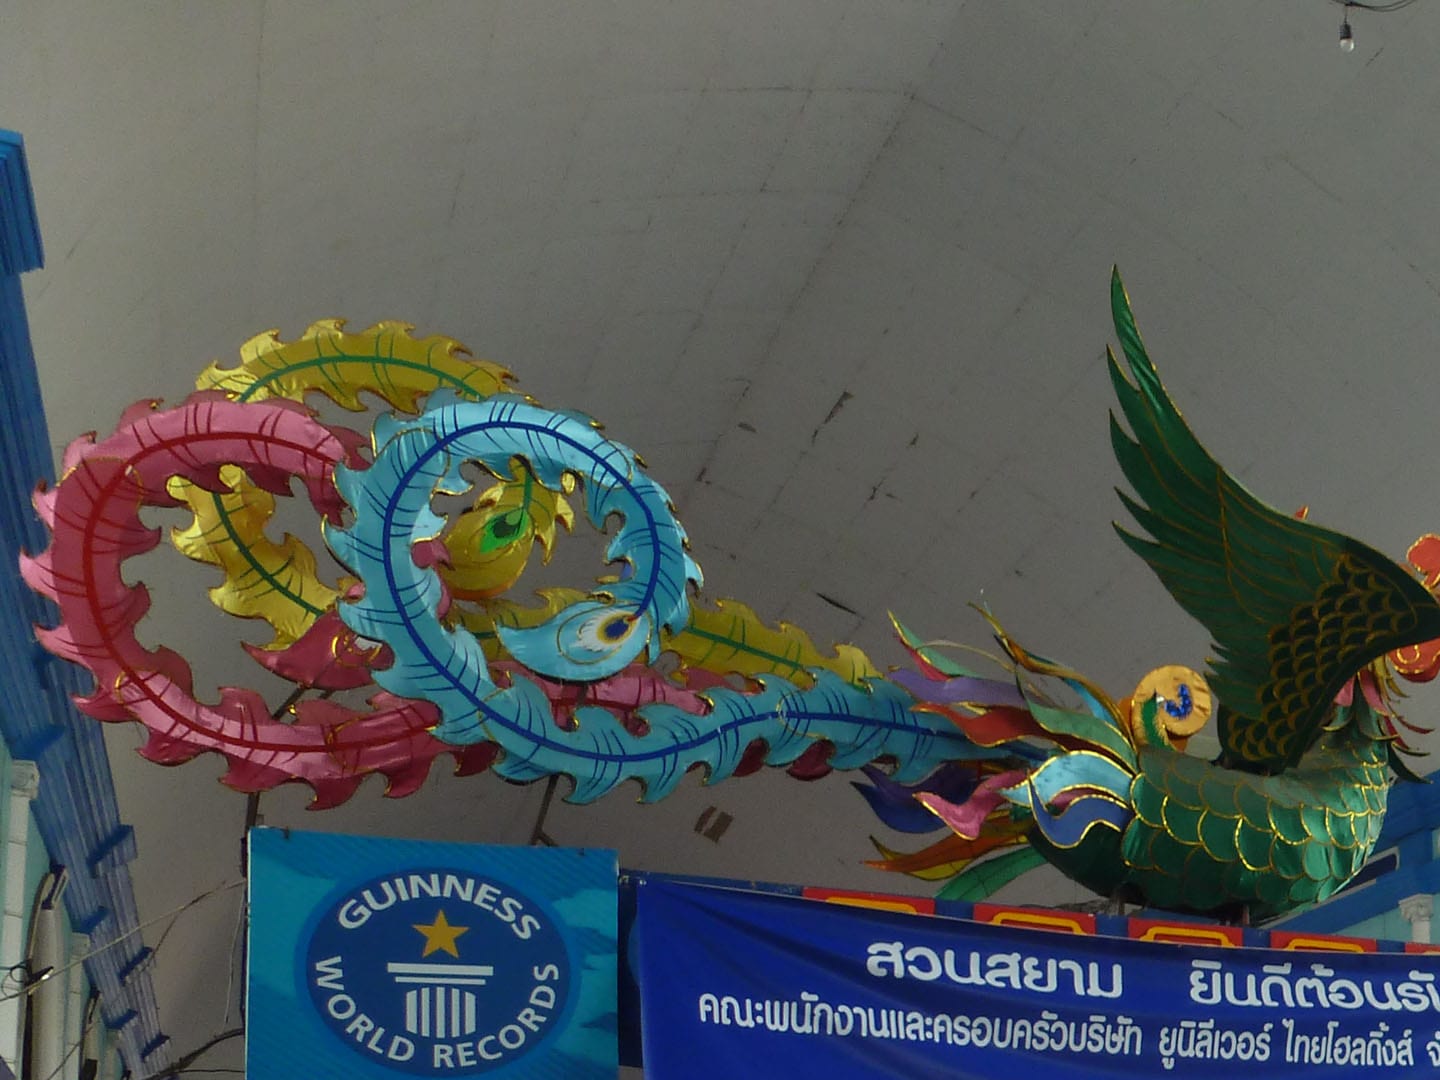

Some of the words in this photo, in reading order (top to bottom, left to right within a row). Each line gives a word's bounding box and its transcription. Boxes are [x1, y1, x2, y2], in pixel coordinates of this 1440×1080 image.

[337, 873, 541, 940] GUINNESS
[866, 941, 1123, 999] สวนสยาม
[314, 955, 415, 1063] WORLD
[433, 963, 560, 1069] RECORDS
[699, 991, 1143, 1057] คณะพนักงานและครอบครัวบริษัท
[1159, 1020, 1273, 1069] ยูนิลีเวอร์
[1283, 1018, 1415, 1068] ไทยโฮลดิ้งส์
